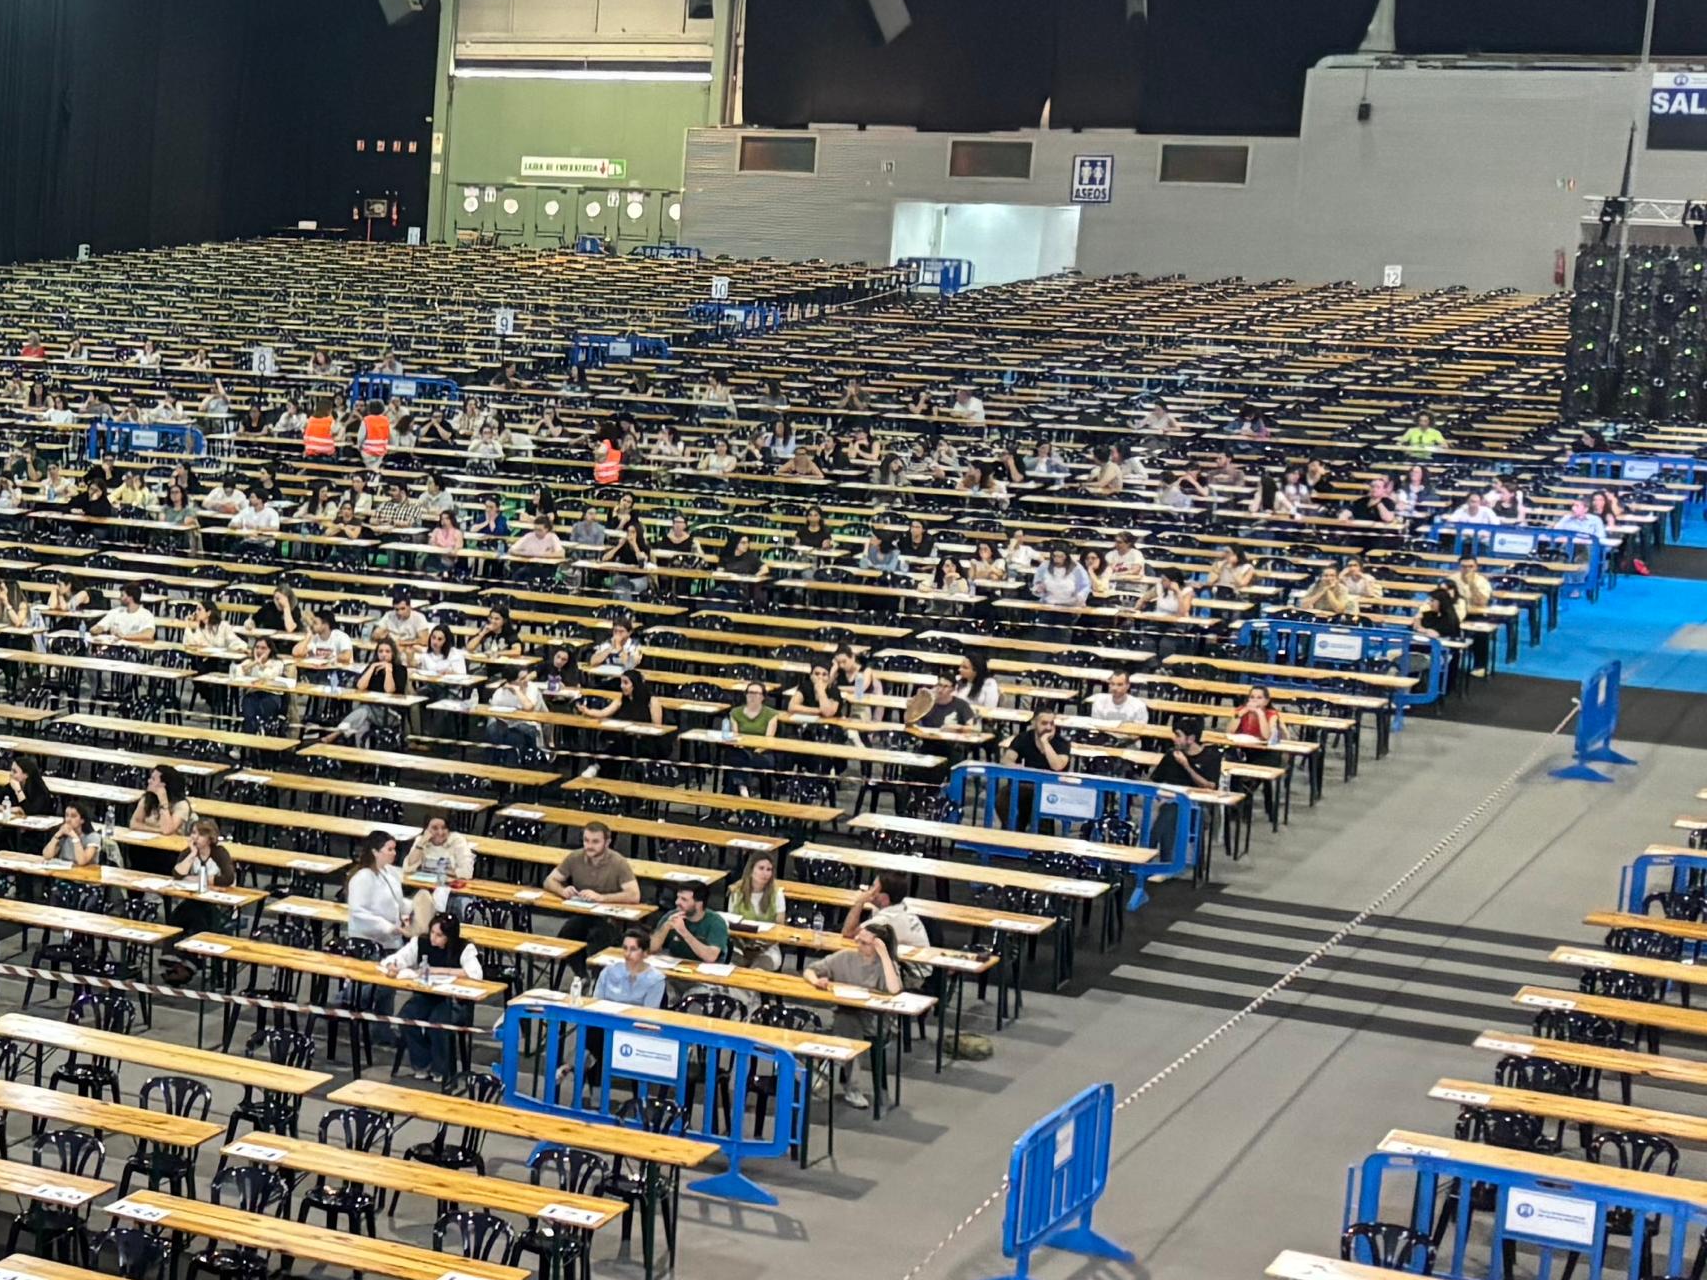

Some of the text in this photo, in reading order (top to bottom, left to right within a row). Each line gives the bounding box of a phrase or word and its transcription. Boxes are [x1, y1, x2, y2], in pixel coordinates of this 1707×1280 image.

[1652, 92, 1707, 115] SAL
[1074, 187, 1108, 200] ASEOS
[715, 283, 727, 296] 10
[500, 317, 509, 333] 9
[258, 353, 266, 372] 8
